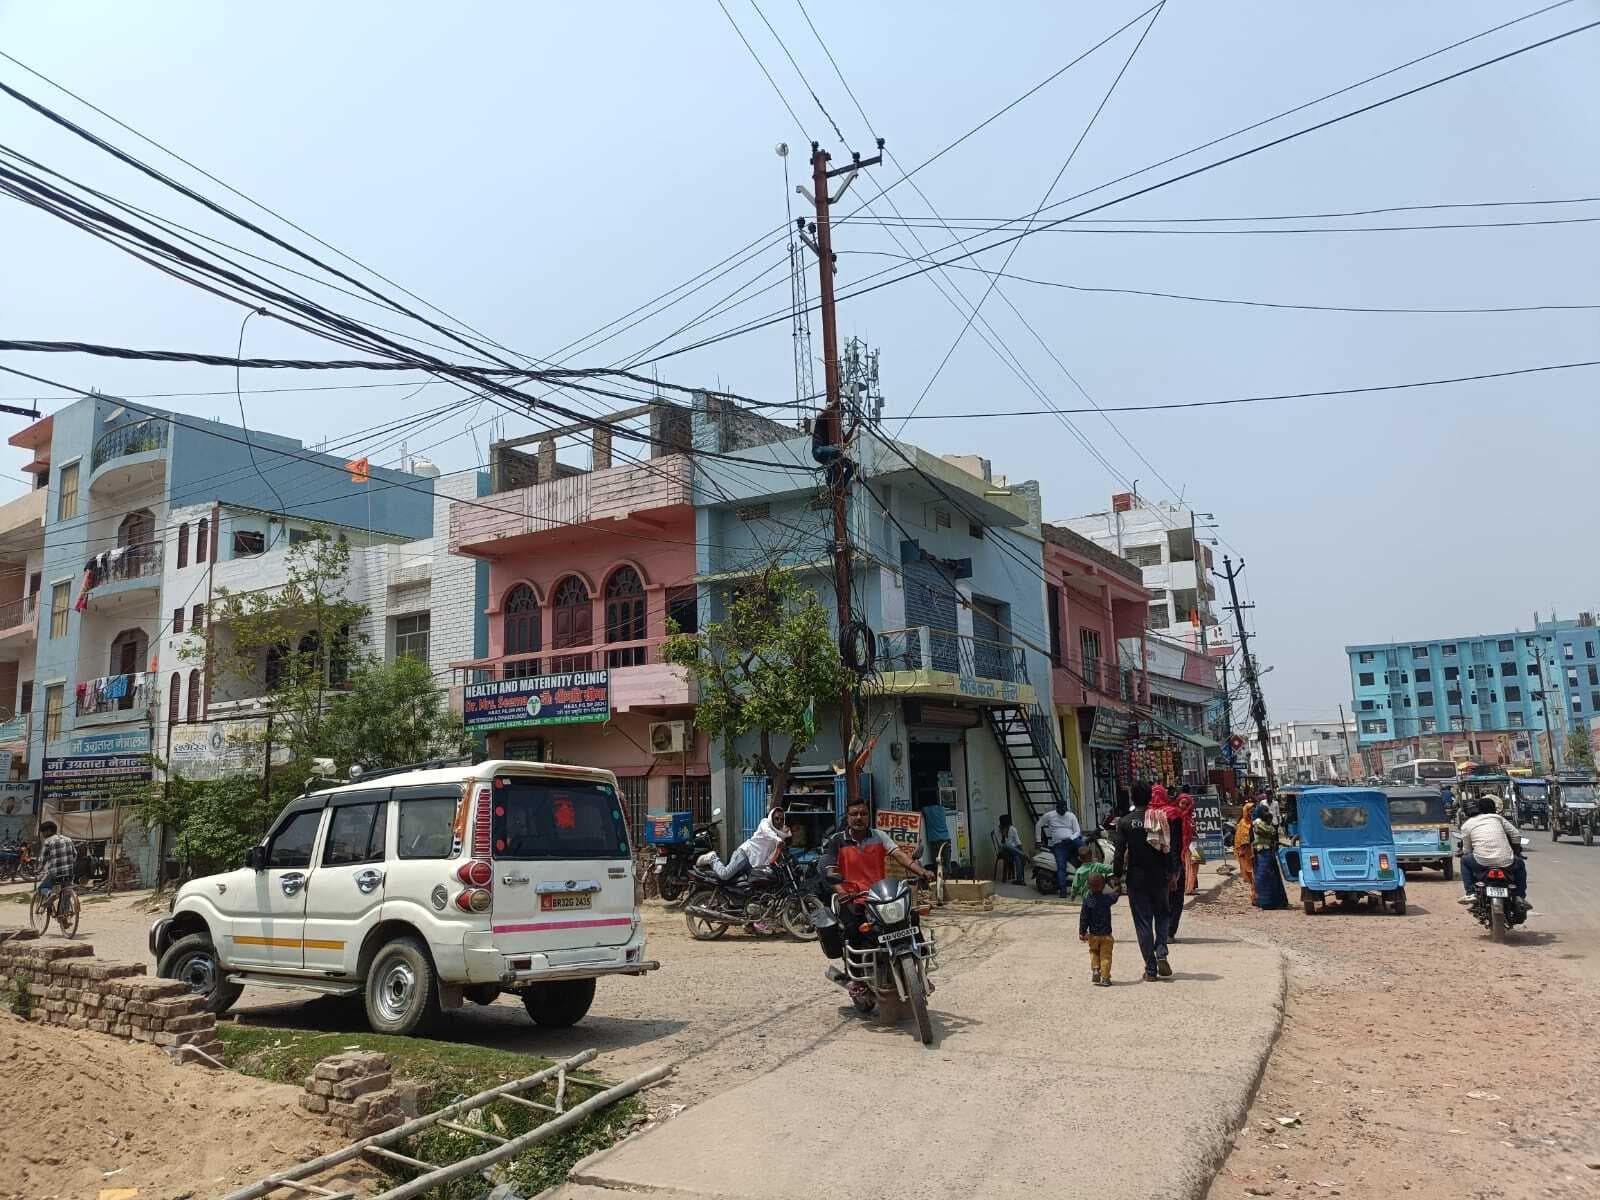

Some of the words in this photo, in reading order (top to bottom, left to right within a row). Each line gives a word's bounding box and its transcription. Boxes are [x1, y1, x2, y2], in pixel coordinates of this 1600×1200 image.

[465, 684, 498, 699] HEALTH
[499, 680, 518, 695] AND
[520, 674, 573, 691] MATERNITY
[573, 671, 607, 687] CLINIC
